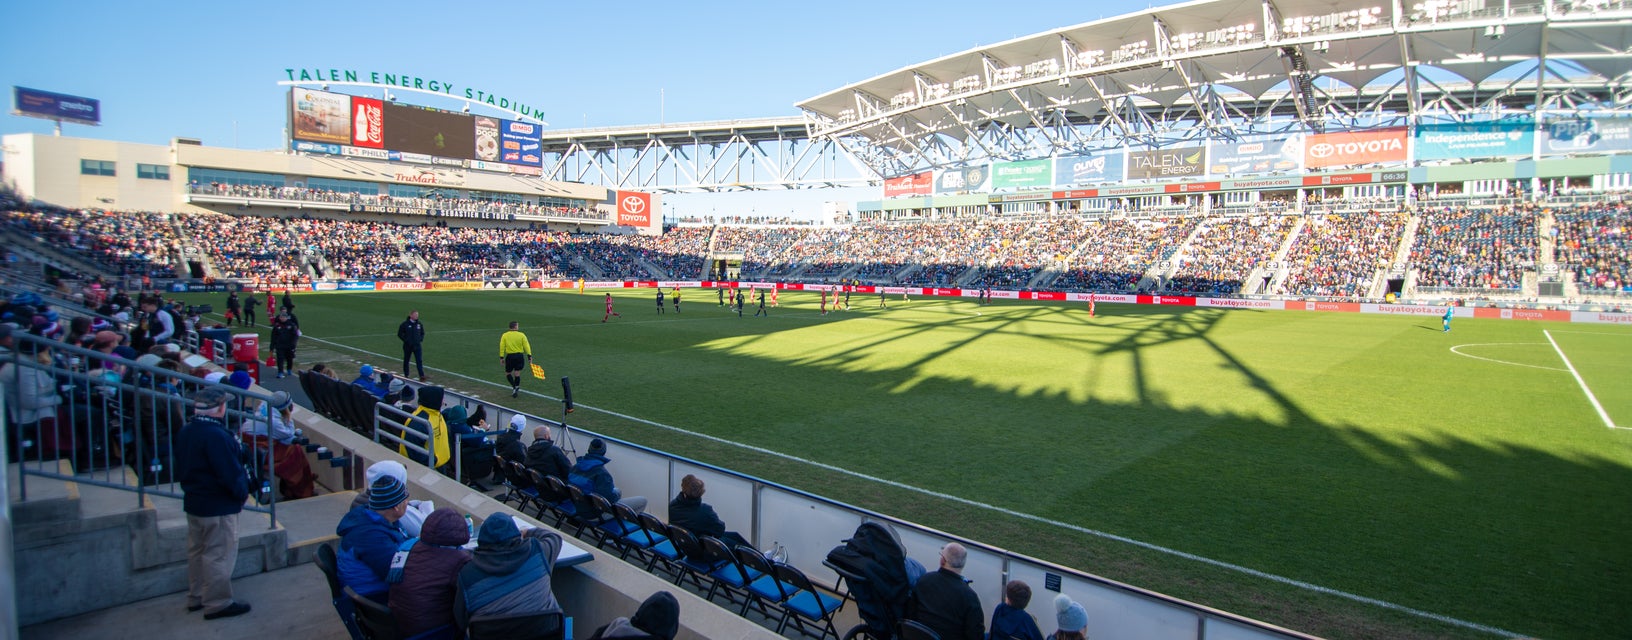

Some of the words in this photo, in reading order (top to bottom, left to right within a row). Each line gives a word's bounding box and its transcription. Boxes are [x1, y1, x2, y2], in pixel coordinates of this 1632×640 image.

[285, 68, 358, 82] TALEN
[371, 72, 453, 94] ENERGY
[465, 88, 545, 122] STADIUM
[367, 103, 382, 143] Coca-Cola
[1425, 132, 1506, 144] Independence
[1336, 138, 1402, 154] TOYOTA
[361, 149, 388, 158] PHILLY
[1133, 154, 1183, 168] TALEN
[1162, 165, 1197, 175] ENERGY
[395, 171, 437, 184] TruMark
[887, 179, 913, 190] TruMark
[1233, 179, 1290, 188] buyatoyota.com
[364, 205, 386, 213] RING
[387, 206, 398, 214] OF
[399, 207, 427, 215] HONOR
[441, 210, 479, 219] SEBASTIEN
[482, 211, 490, 219] LE
[620, 214, 648, 222] TOYOTA
[1210, 299, 1271, 308] buyatoyota.com
